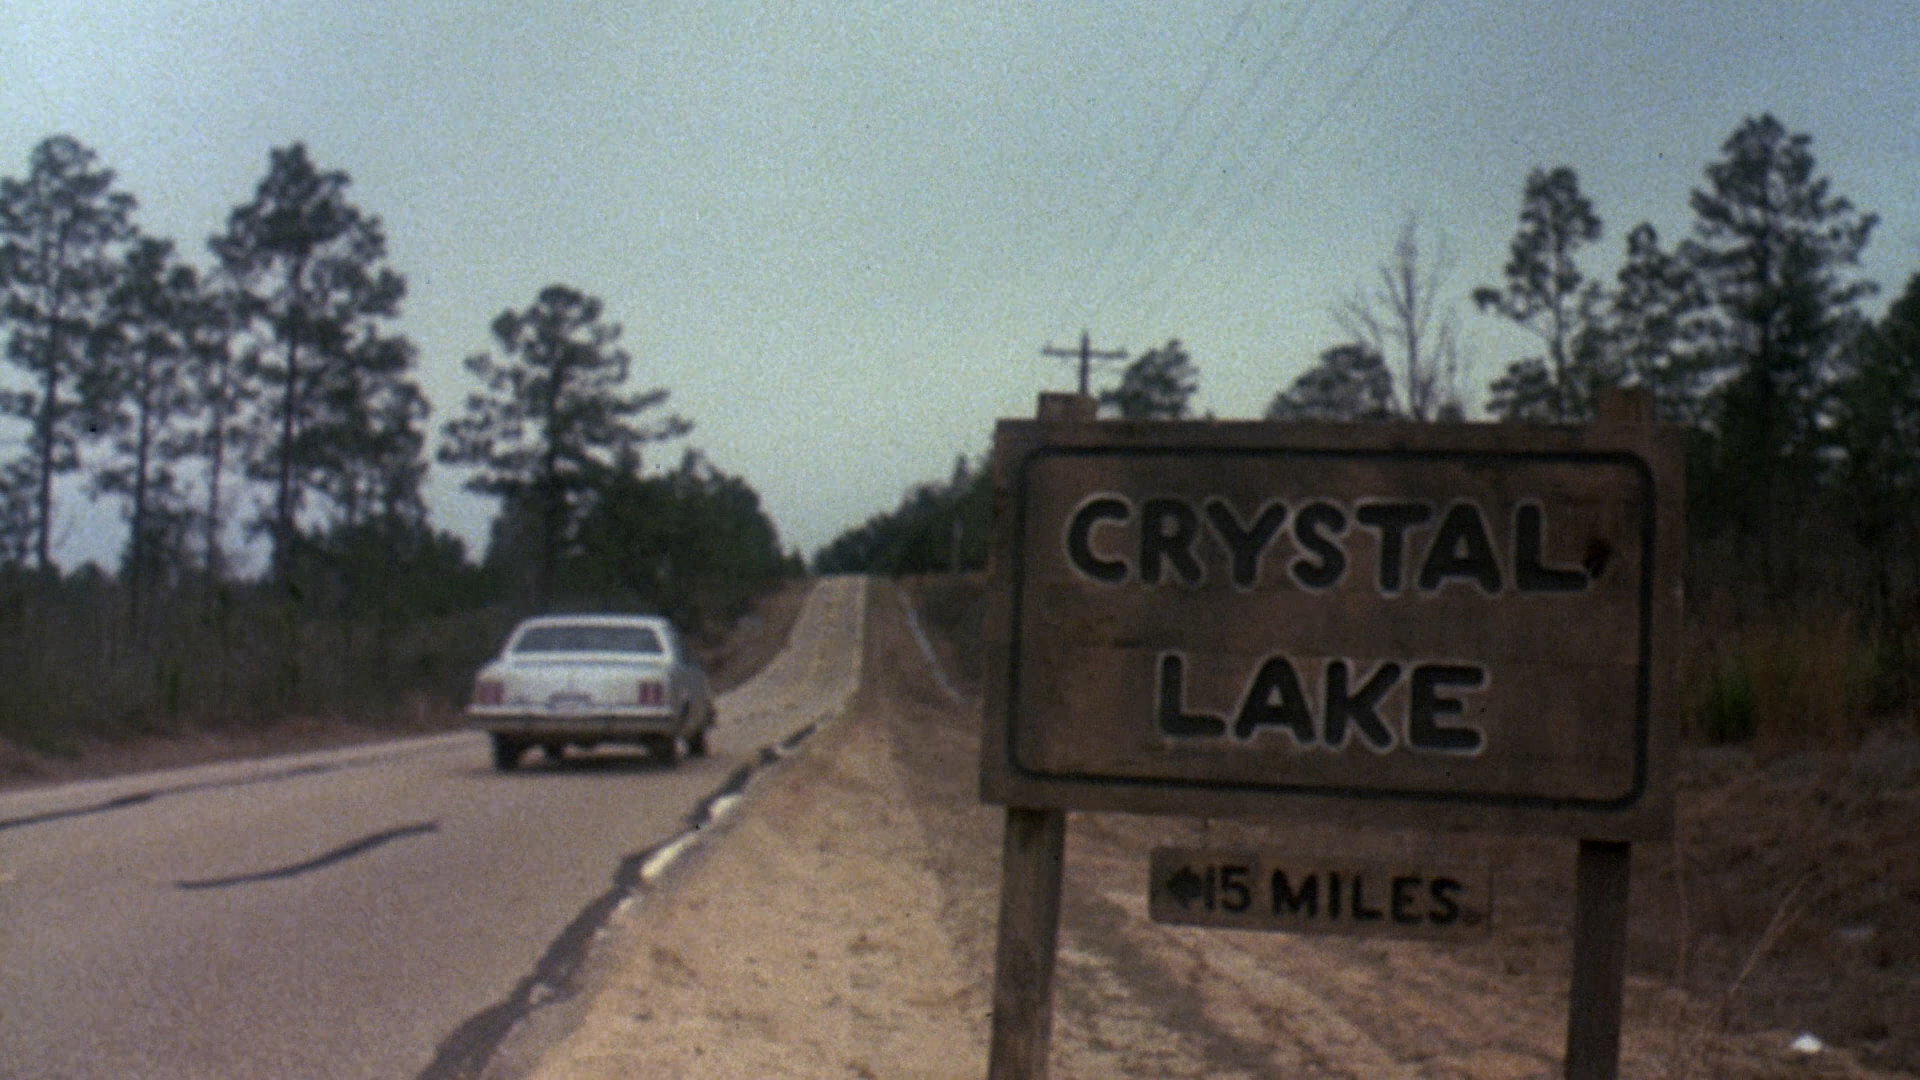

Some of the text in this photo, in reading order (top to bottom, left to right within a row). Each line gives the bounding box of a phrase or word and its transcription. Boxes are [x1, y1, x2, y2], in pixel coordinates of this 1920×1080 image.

[1066, 494, 1593, 595] CRYSTAL
[1157, 651, 1488, 755] LAKE
[1204, 865, 1463, 925] 15 MILES
